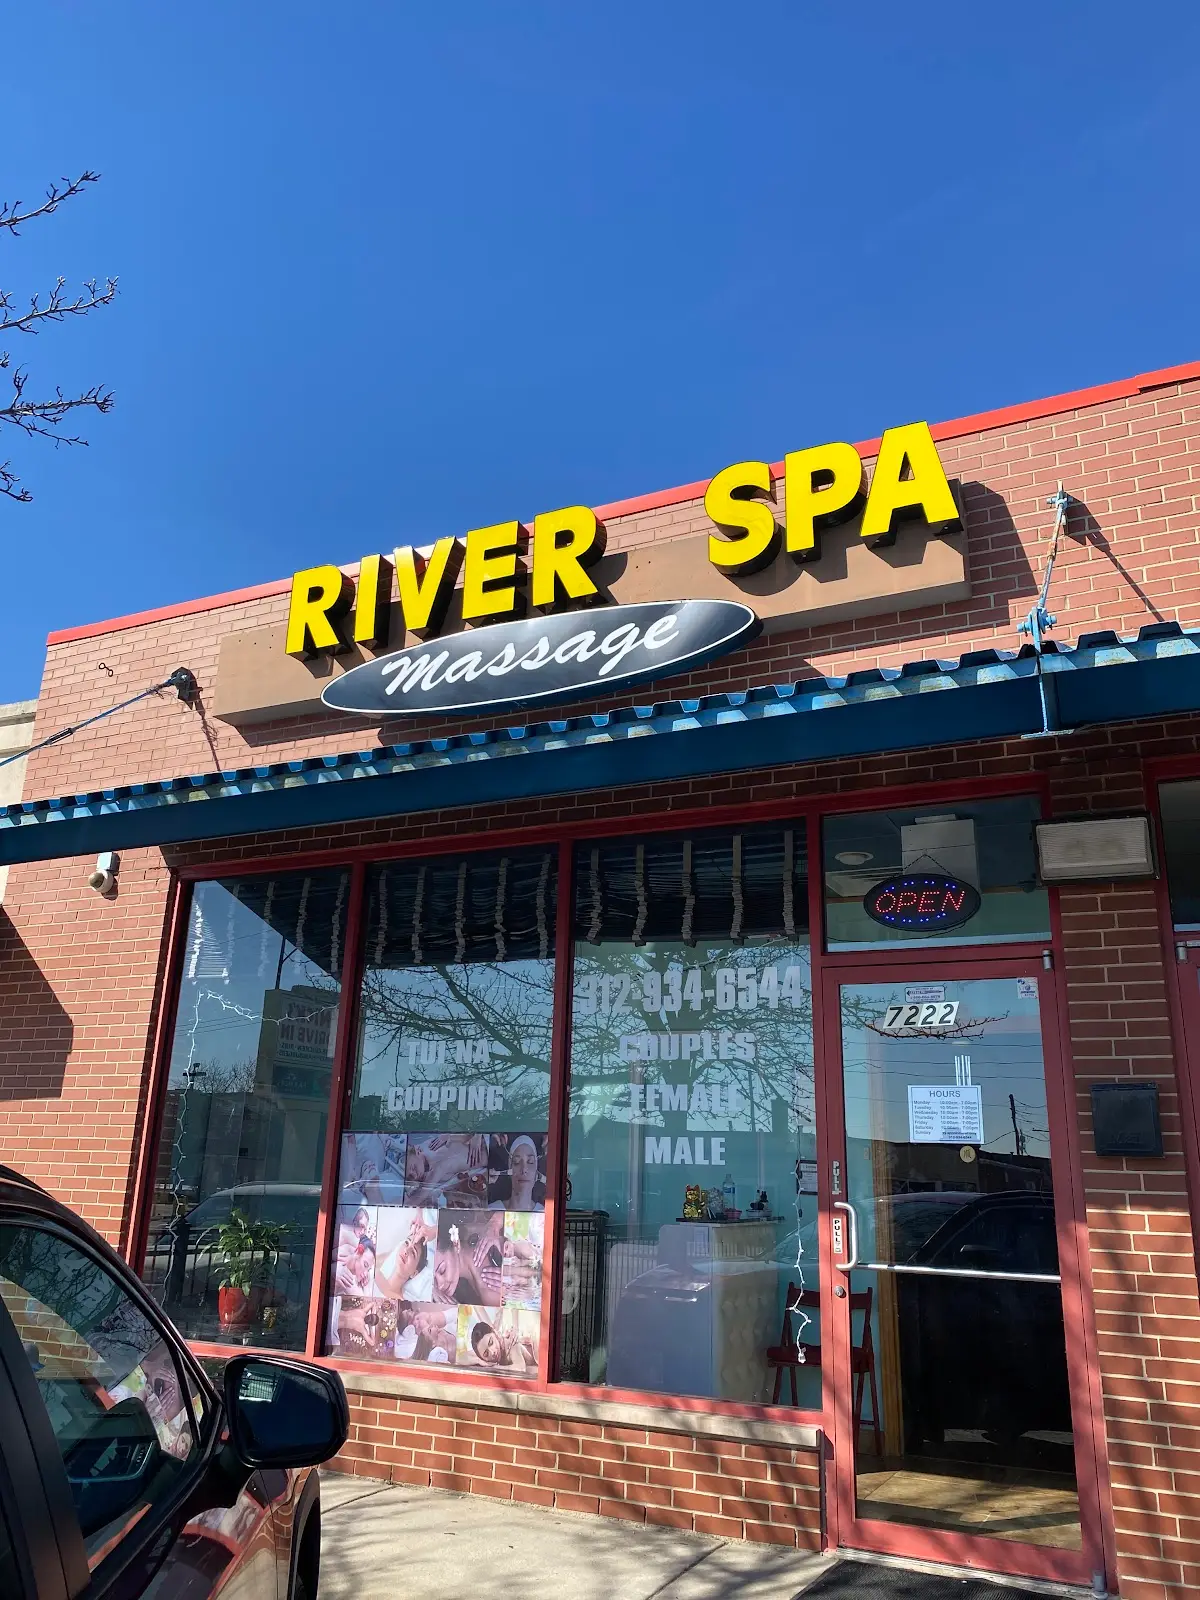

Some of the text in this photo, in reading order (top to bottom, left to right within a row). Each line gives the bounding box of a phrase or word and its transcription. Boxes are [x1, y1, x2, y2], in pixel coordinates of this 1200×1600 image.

[285, 421, 960, 655] RIVER SPA
[381, 611, 680, 696] Massage
[875, 890, 966, 913] OPEN
[579, 965, 801, 1015] 312-934-6544
[887, 1003, 955, 1027] 7222
[456, 1039, 490, 1064] NA
[619, 1032, 756, 1061] COUPLES
[388, 1085, 504, 1111] CUPPING
[630, 1084, 744, 1112] FEMALE
[929, 1090, 961, 1098] HOURS
[644, 1136, 726, 1166] MALE
[832, 1160, 840, 1192] PULL
